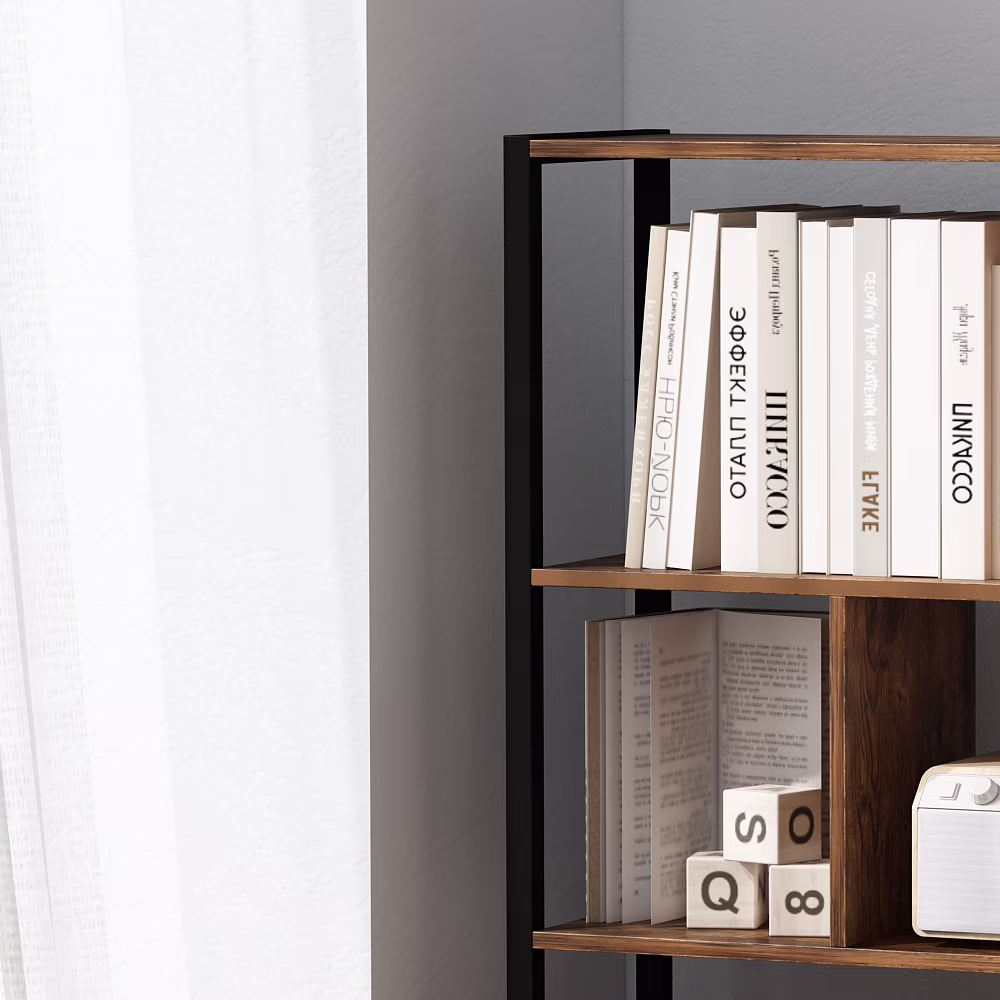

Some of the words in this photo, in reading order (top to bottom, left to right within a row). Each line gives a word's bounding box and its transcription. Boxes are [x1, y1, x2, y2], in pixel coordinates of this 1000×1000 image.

[734, 812, 767, 844] S
[701, 870, 740, 915] Q
[784, 889, 825, 916] 8
